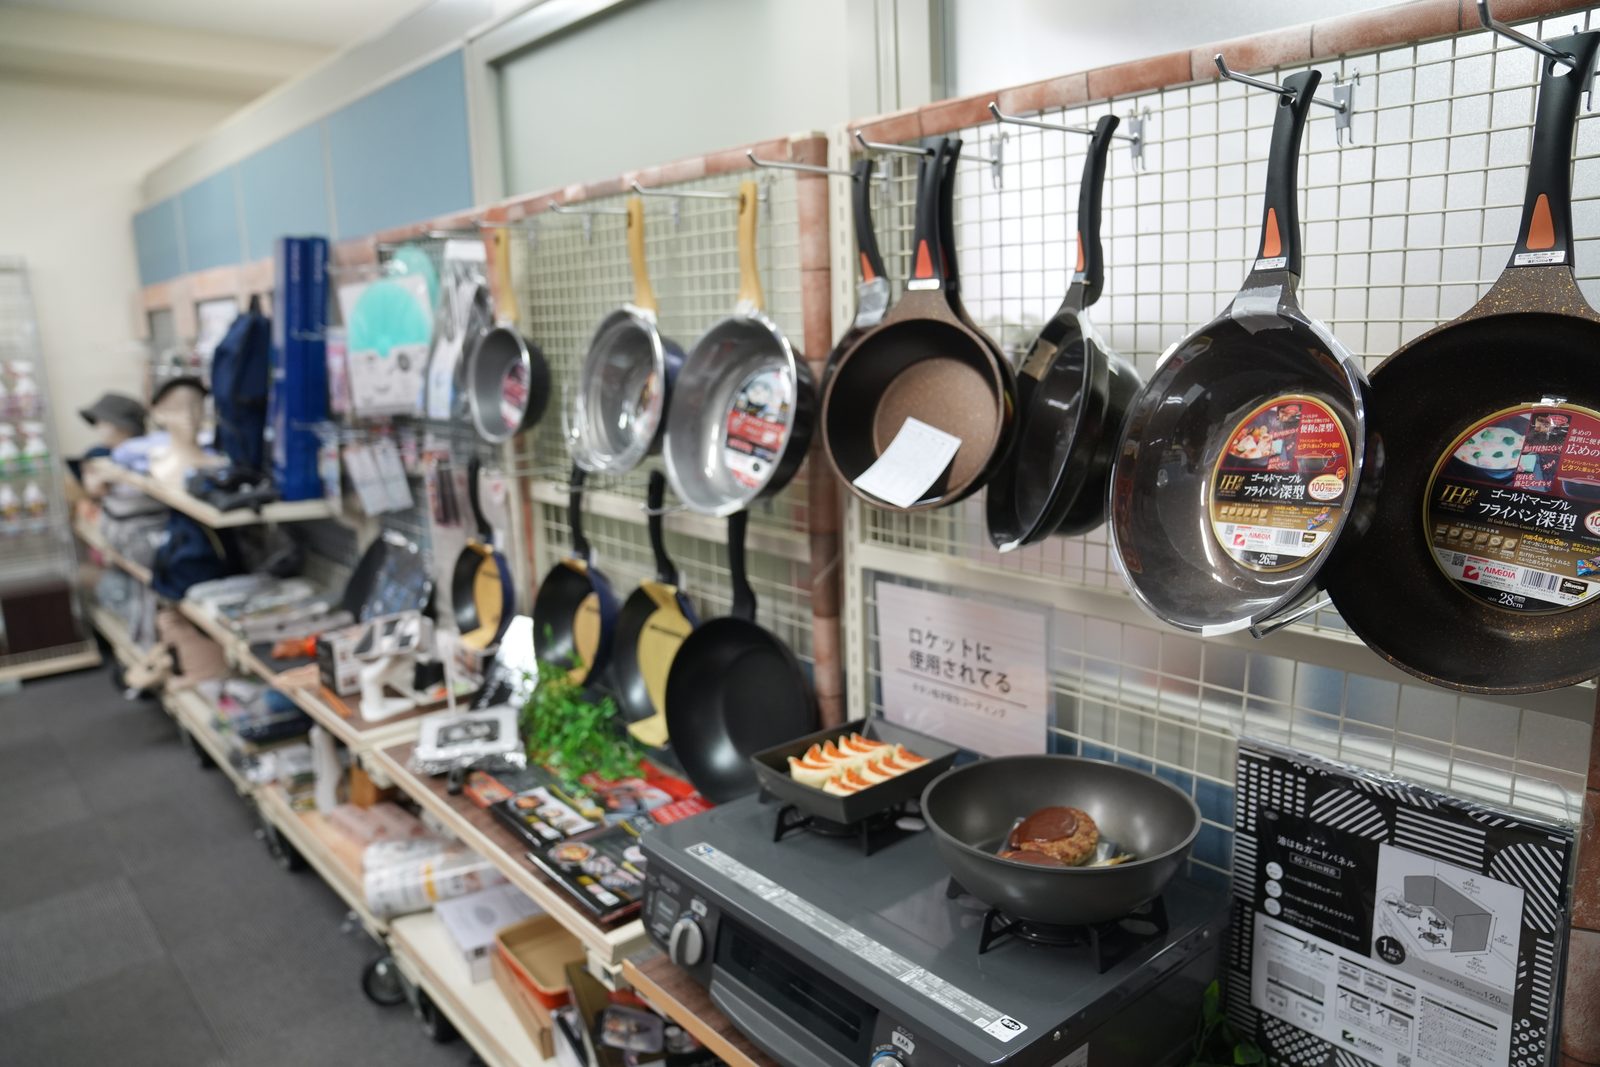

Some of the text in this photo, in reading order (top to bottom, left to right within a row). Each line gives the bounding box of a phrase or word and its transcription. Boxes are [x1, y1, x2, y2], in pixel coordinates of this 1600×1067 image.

[1565, 443, 1600, 457] 広めの
[1251, 473, 1302, 484] ゴールドマーブル
[1244, 484, 1305, 500] フライパン深型
[1491, 489, 1572, 511] ゴールドマーブル
[1479, 502, 1577, 532] フライパン深型
[1483, 566, 1516, 580] AIMEDIA
[909, 627, 993, 663] ロケットに
[909, 649, 1011, 693] 使用されてる
[1277, 834, 1357, 868] 油はねガードパネル
